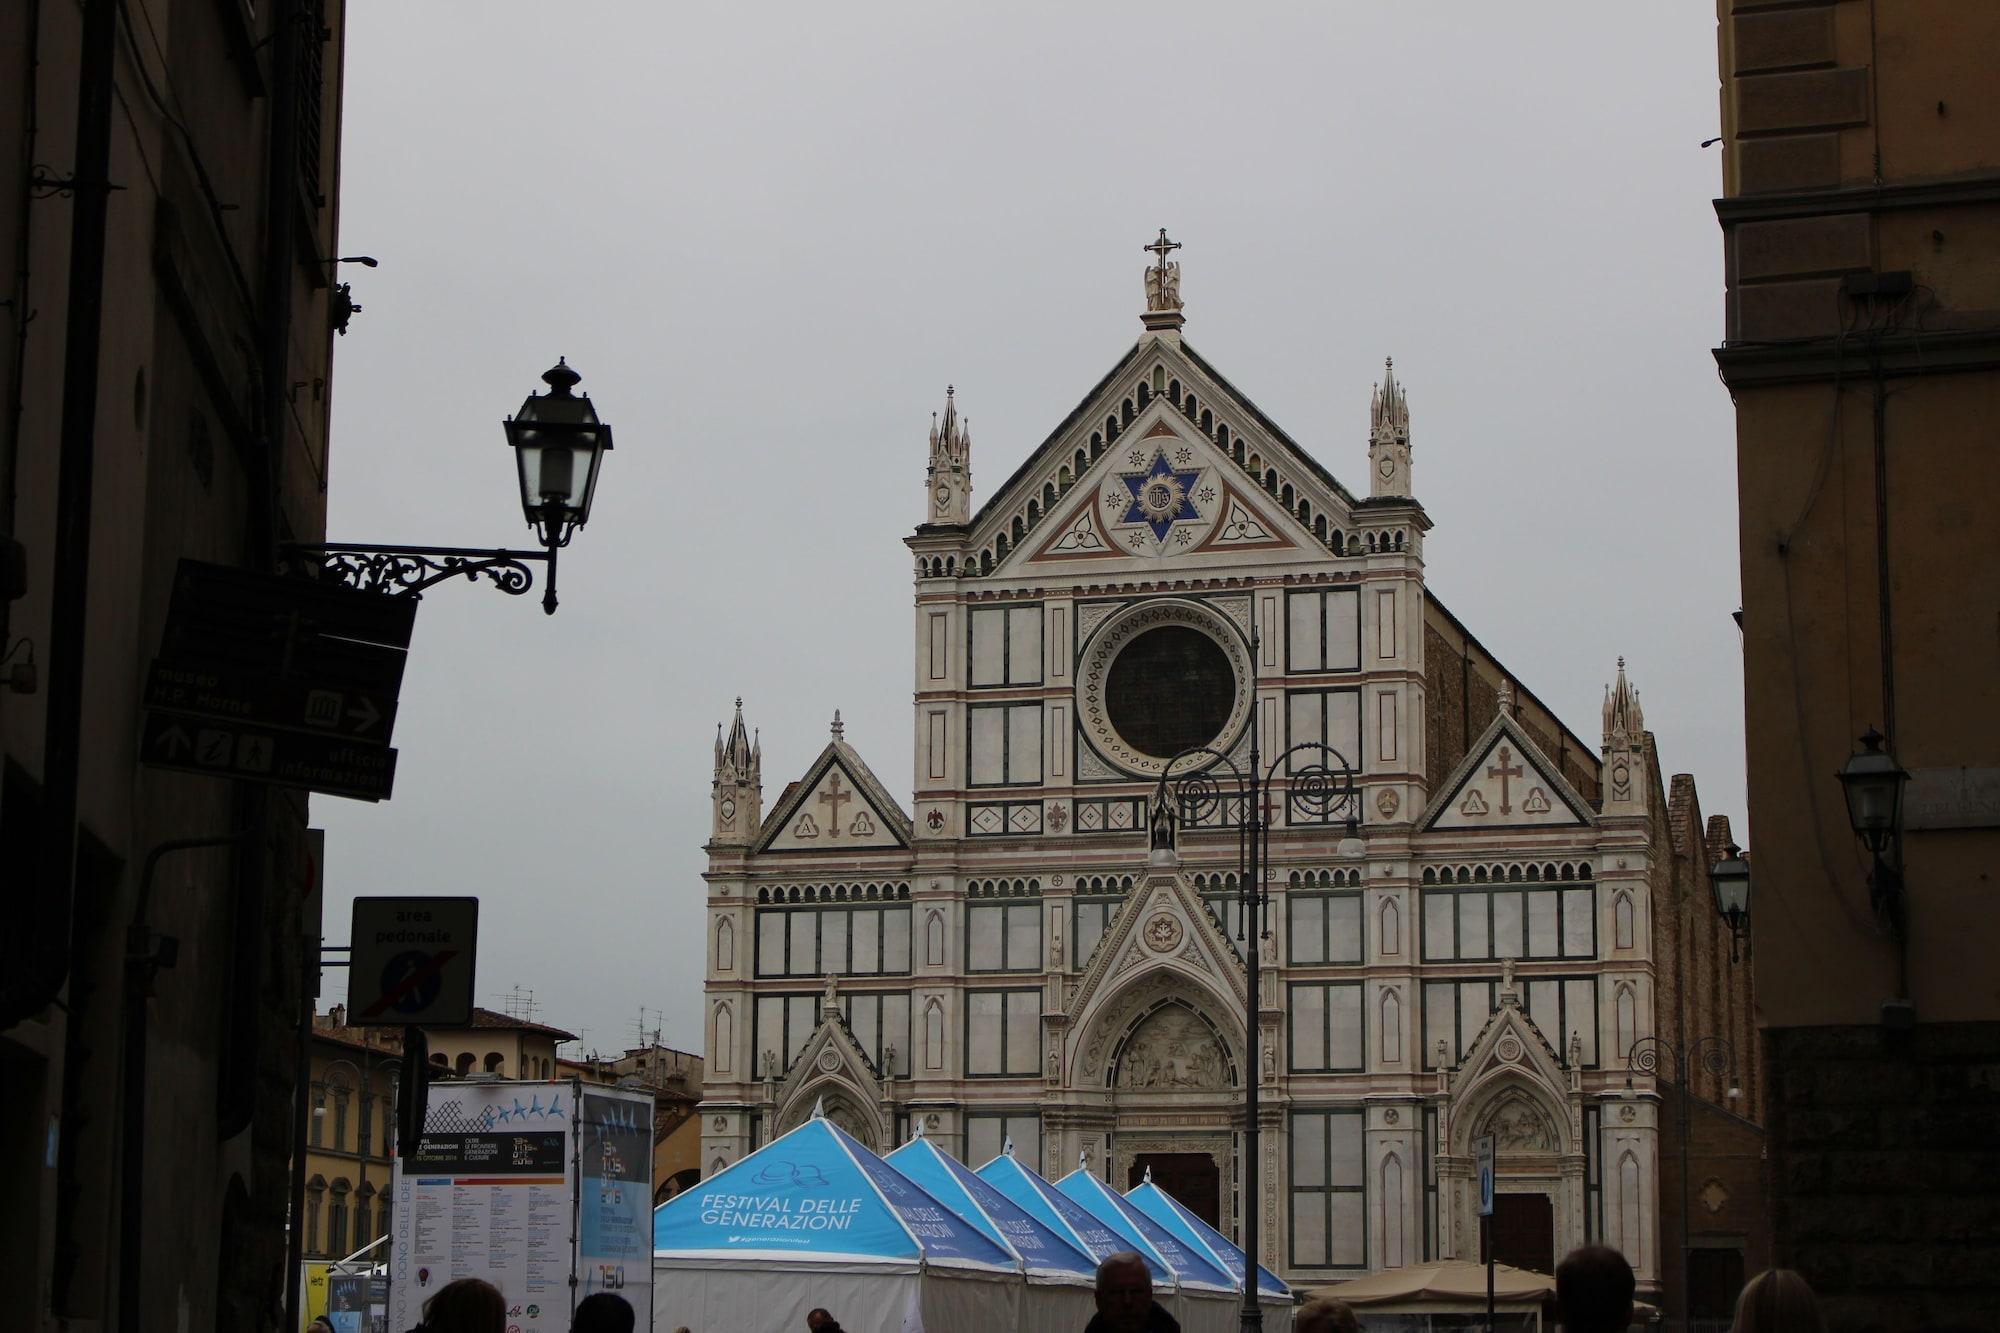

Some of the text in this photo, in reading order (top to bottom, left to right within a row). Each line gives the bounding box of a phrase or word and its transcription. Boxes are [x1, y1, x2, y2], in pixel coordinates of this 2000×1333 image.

[156, 668, 221, 689] museo
[327, 747, 388, 768] ufficio
[278, 760, 387, 786] informazioni
[396, 910, 432, 922] area
[375, 928, 452, 945] pedonale
[701, 1194, 863, 1214] FESTIVAL DELLE
[399, 1207, 409, 1239] DELLE
[701, 1209, 852, 1230] GENERAZIONI
[398, 1242, 408, 1280] DONO
[599, 1265, 625, 1289] 150
